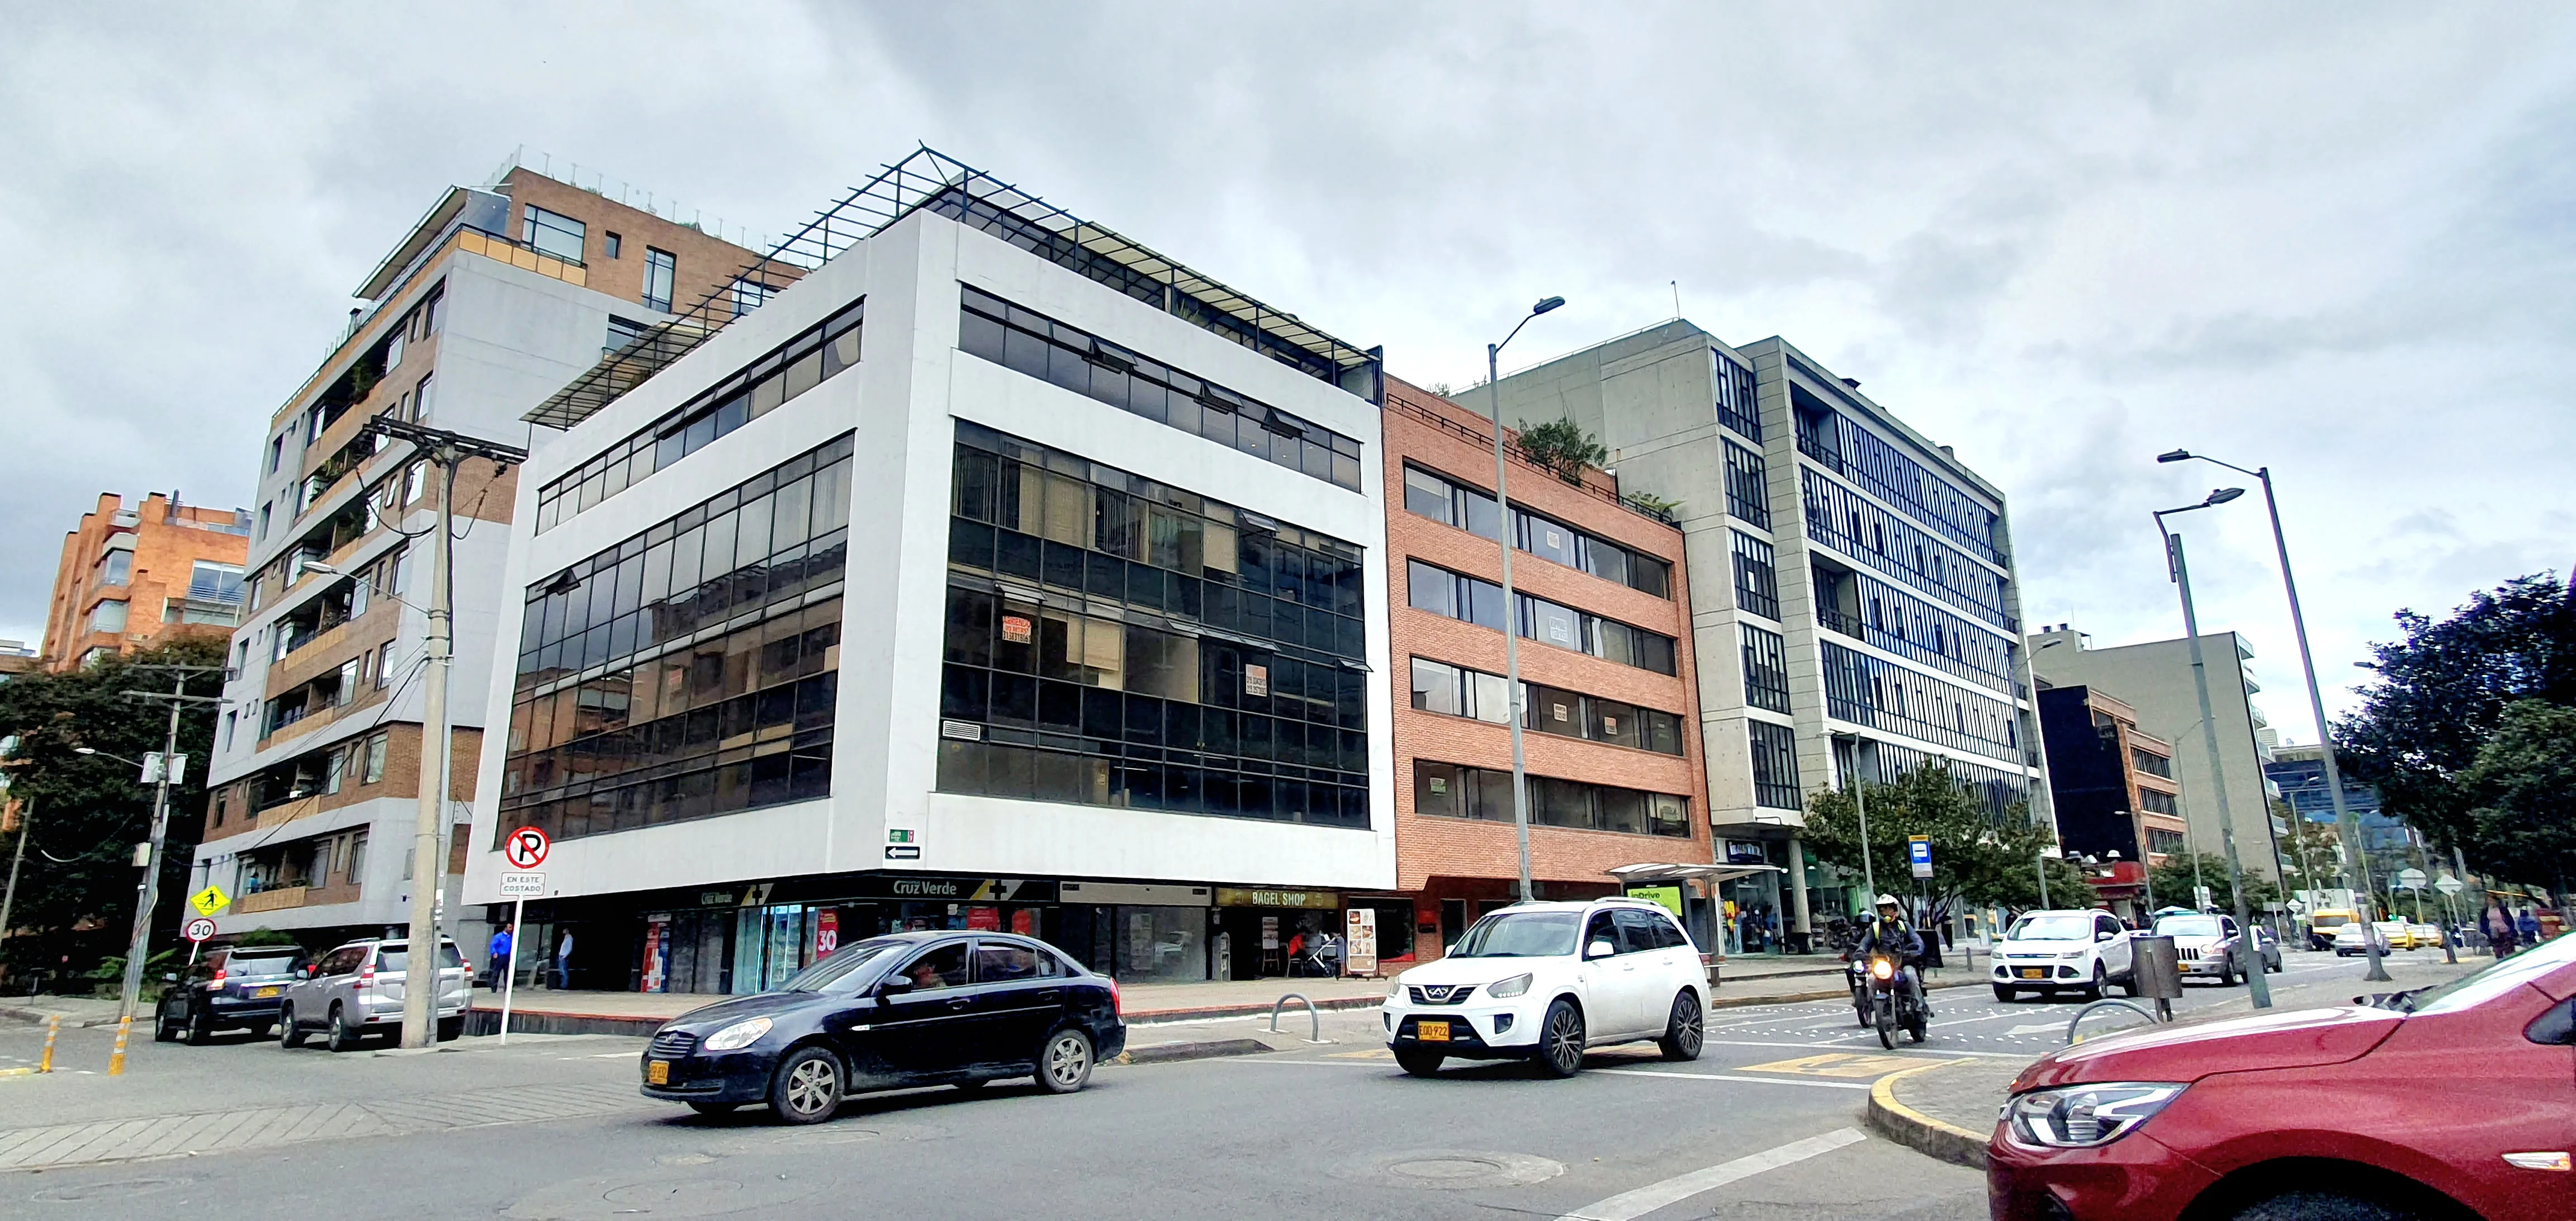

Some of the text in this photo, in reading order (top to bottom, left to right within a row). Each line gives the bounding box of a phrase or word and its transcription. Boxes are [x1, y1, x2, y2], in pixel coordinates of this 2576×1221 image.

[893, 880, 957, 895] Cruz Verde
[1252, 891, 1306, 906] BAGEL SHOP
[192, 924, 211, 936] 30
[818, 930, 837, 952] 30
